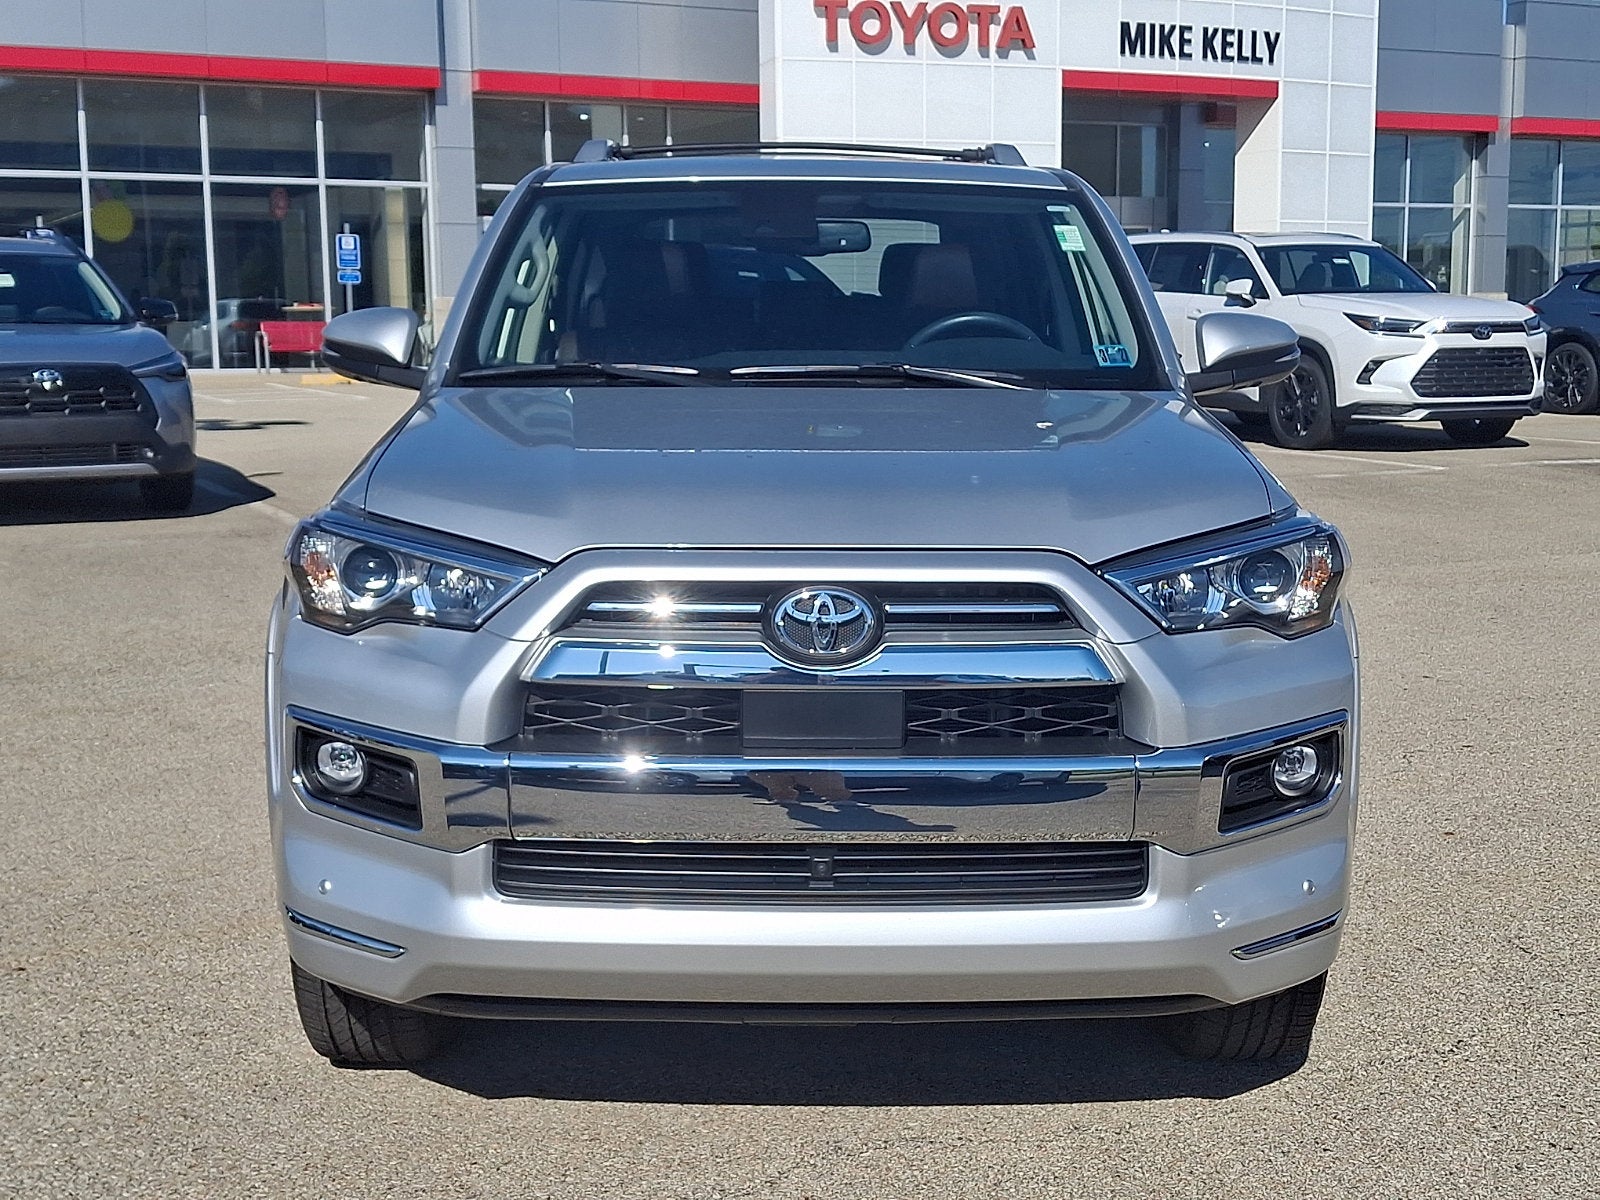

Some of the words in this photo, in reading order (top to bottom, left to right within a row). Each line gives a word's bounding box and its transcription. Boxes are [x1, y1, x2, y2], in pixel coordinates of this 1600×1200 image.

[814, 0, 1036, 50] TOYOTA
[1120, 21, 1192, 60] MIKE
[1202, 26, 1280, 65] KELLY
